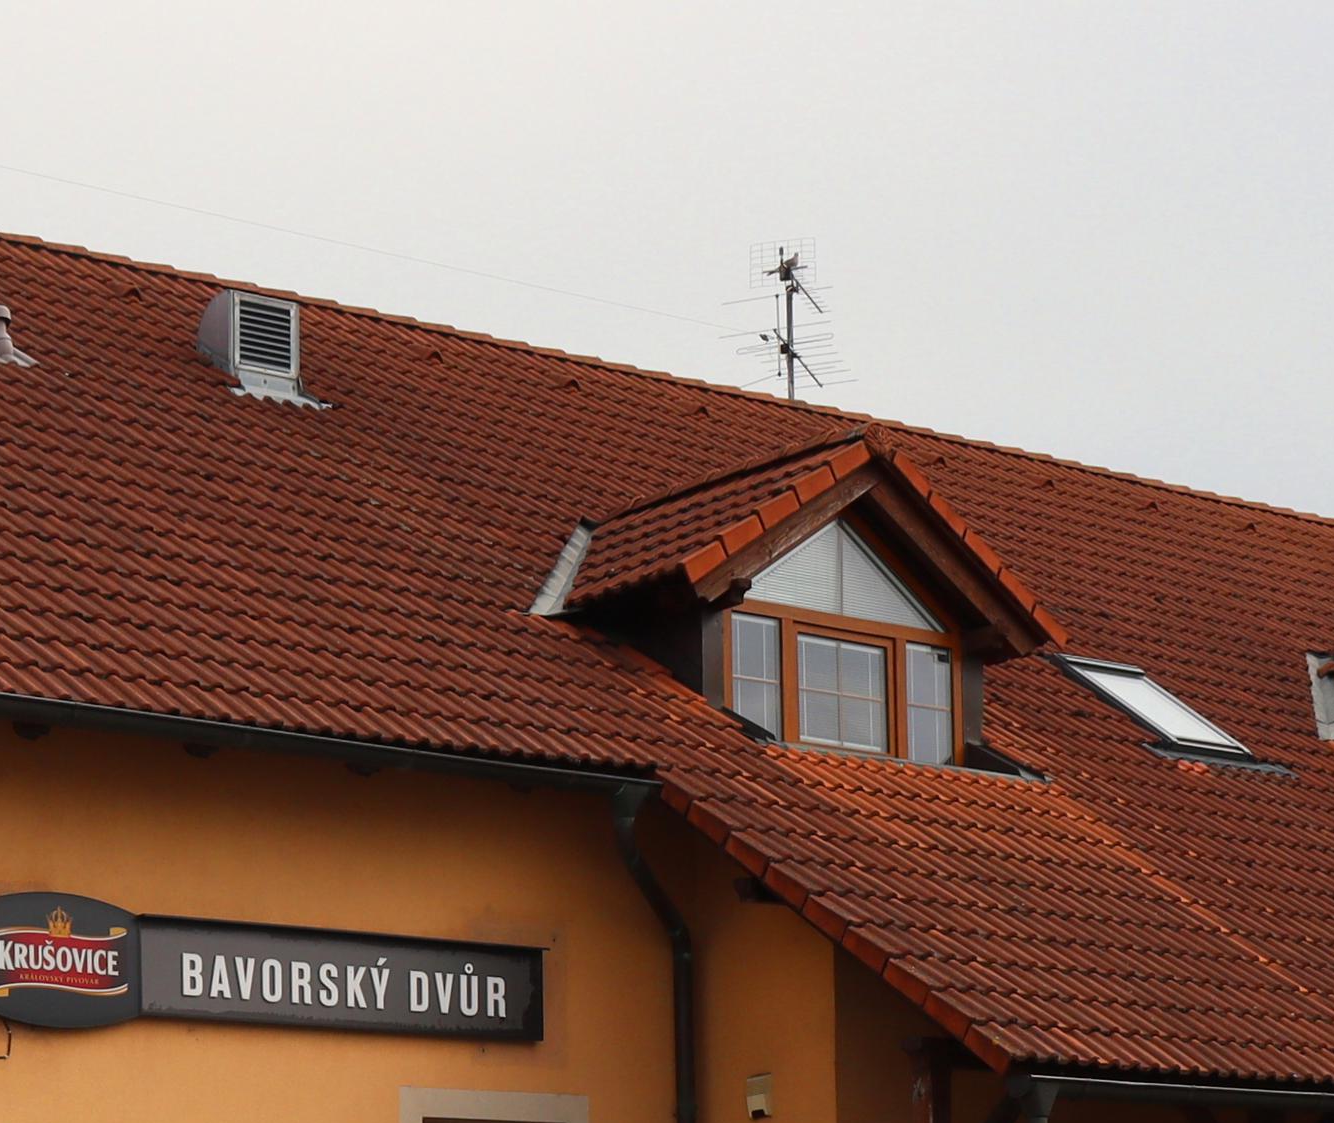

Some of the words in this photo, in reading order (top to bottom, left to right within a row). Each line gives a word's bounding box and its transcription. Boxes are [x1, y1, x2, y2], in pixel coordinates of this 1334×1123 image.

[66, 976, 100, 985] PIVOVAR
[182, 952, 390, 1010] BAVORSKÝ
[410, 963, 507, 1018] DVŮR
